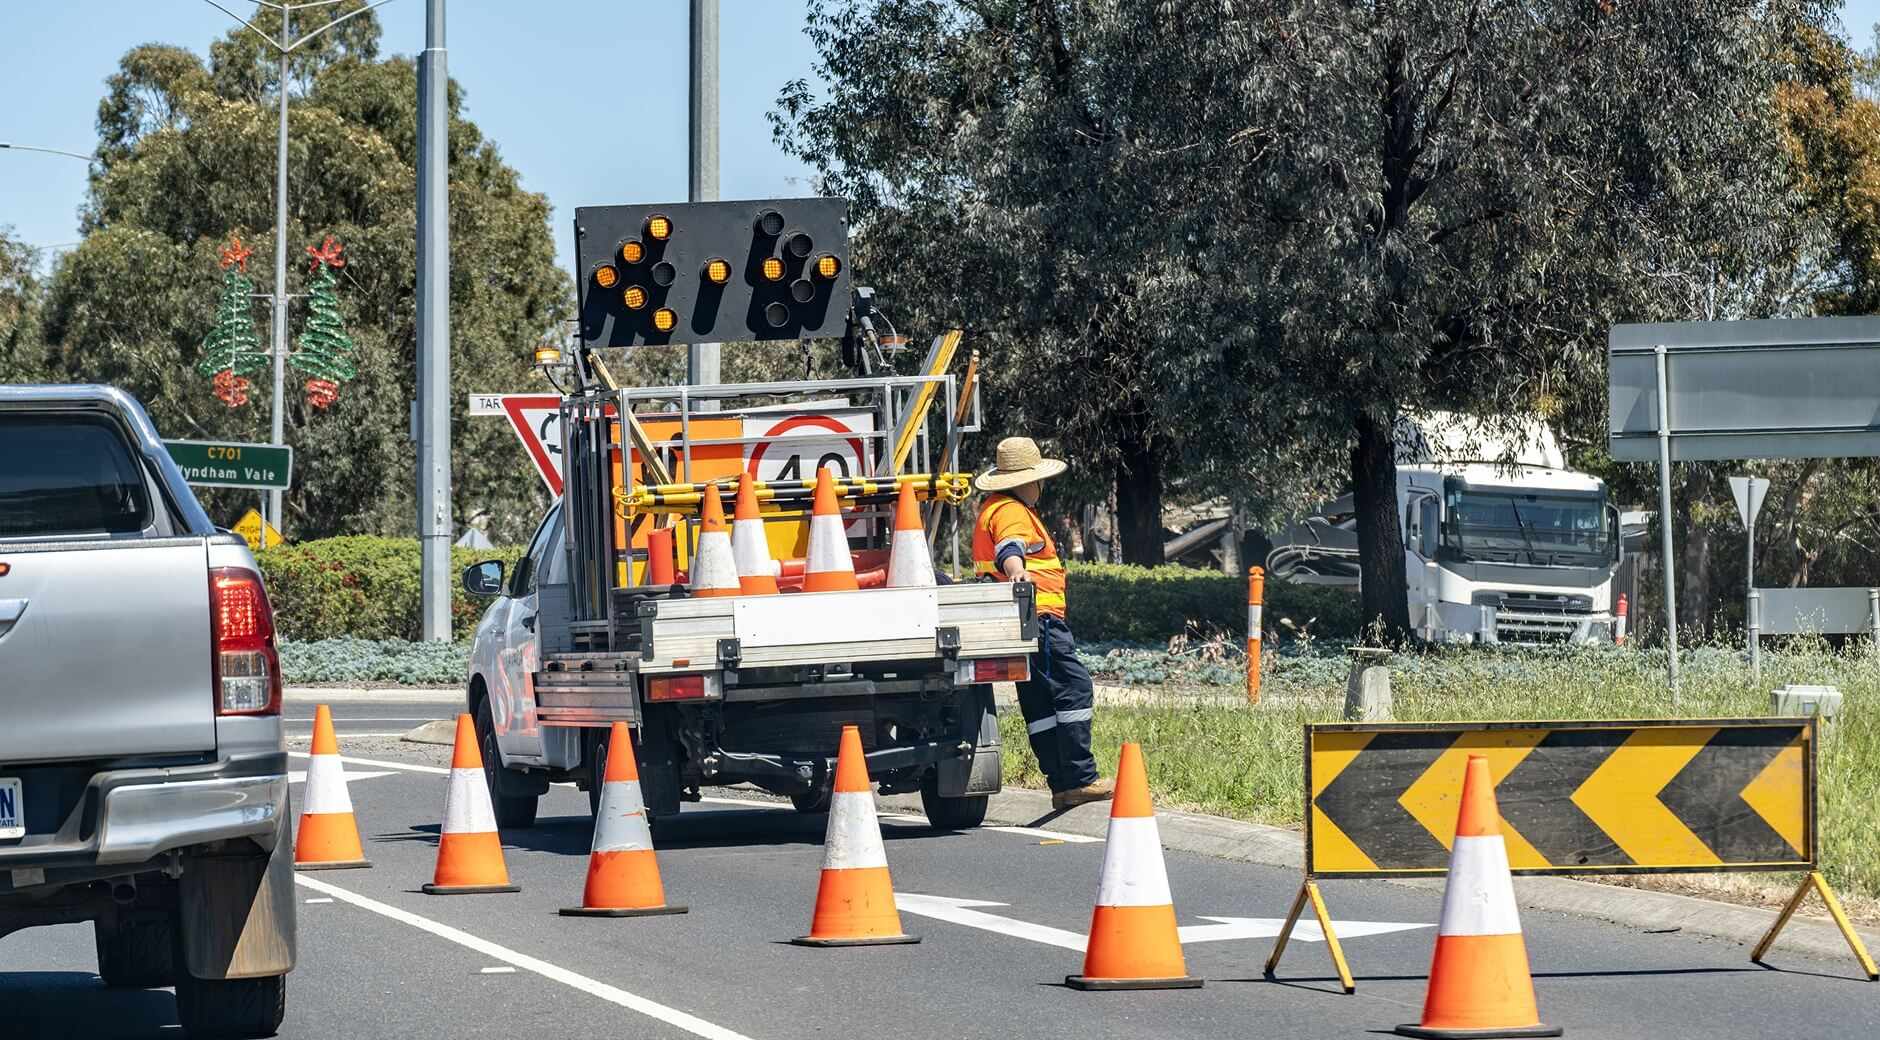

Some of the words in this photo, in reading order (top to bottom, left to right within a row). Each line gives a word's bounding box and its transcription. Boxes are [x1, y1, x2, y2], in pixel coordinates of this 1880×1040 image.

[479, 398, 501, 409] TAR
[207, 447, 241, 460] C701
[244, 467, 275, 481] Vale
[0, 819, 16, 828] ATE
